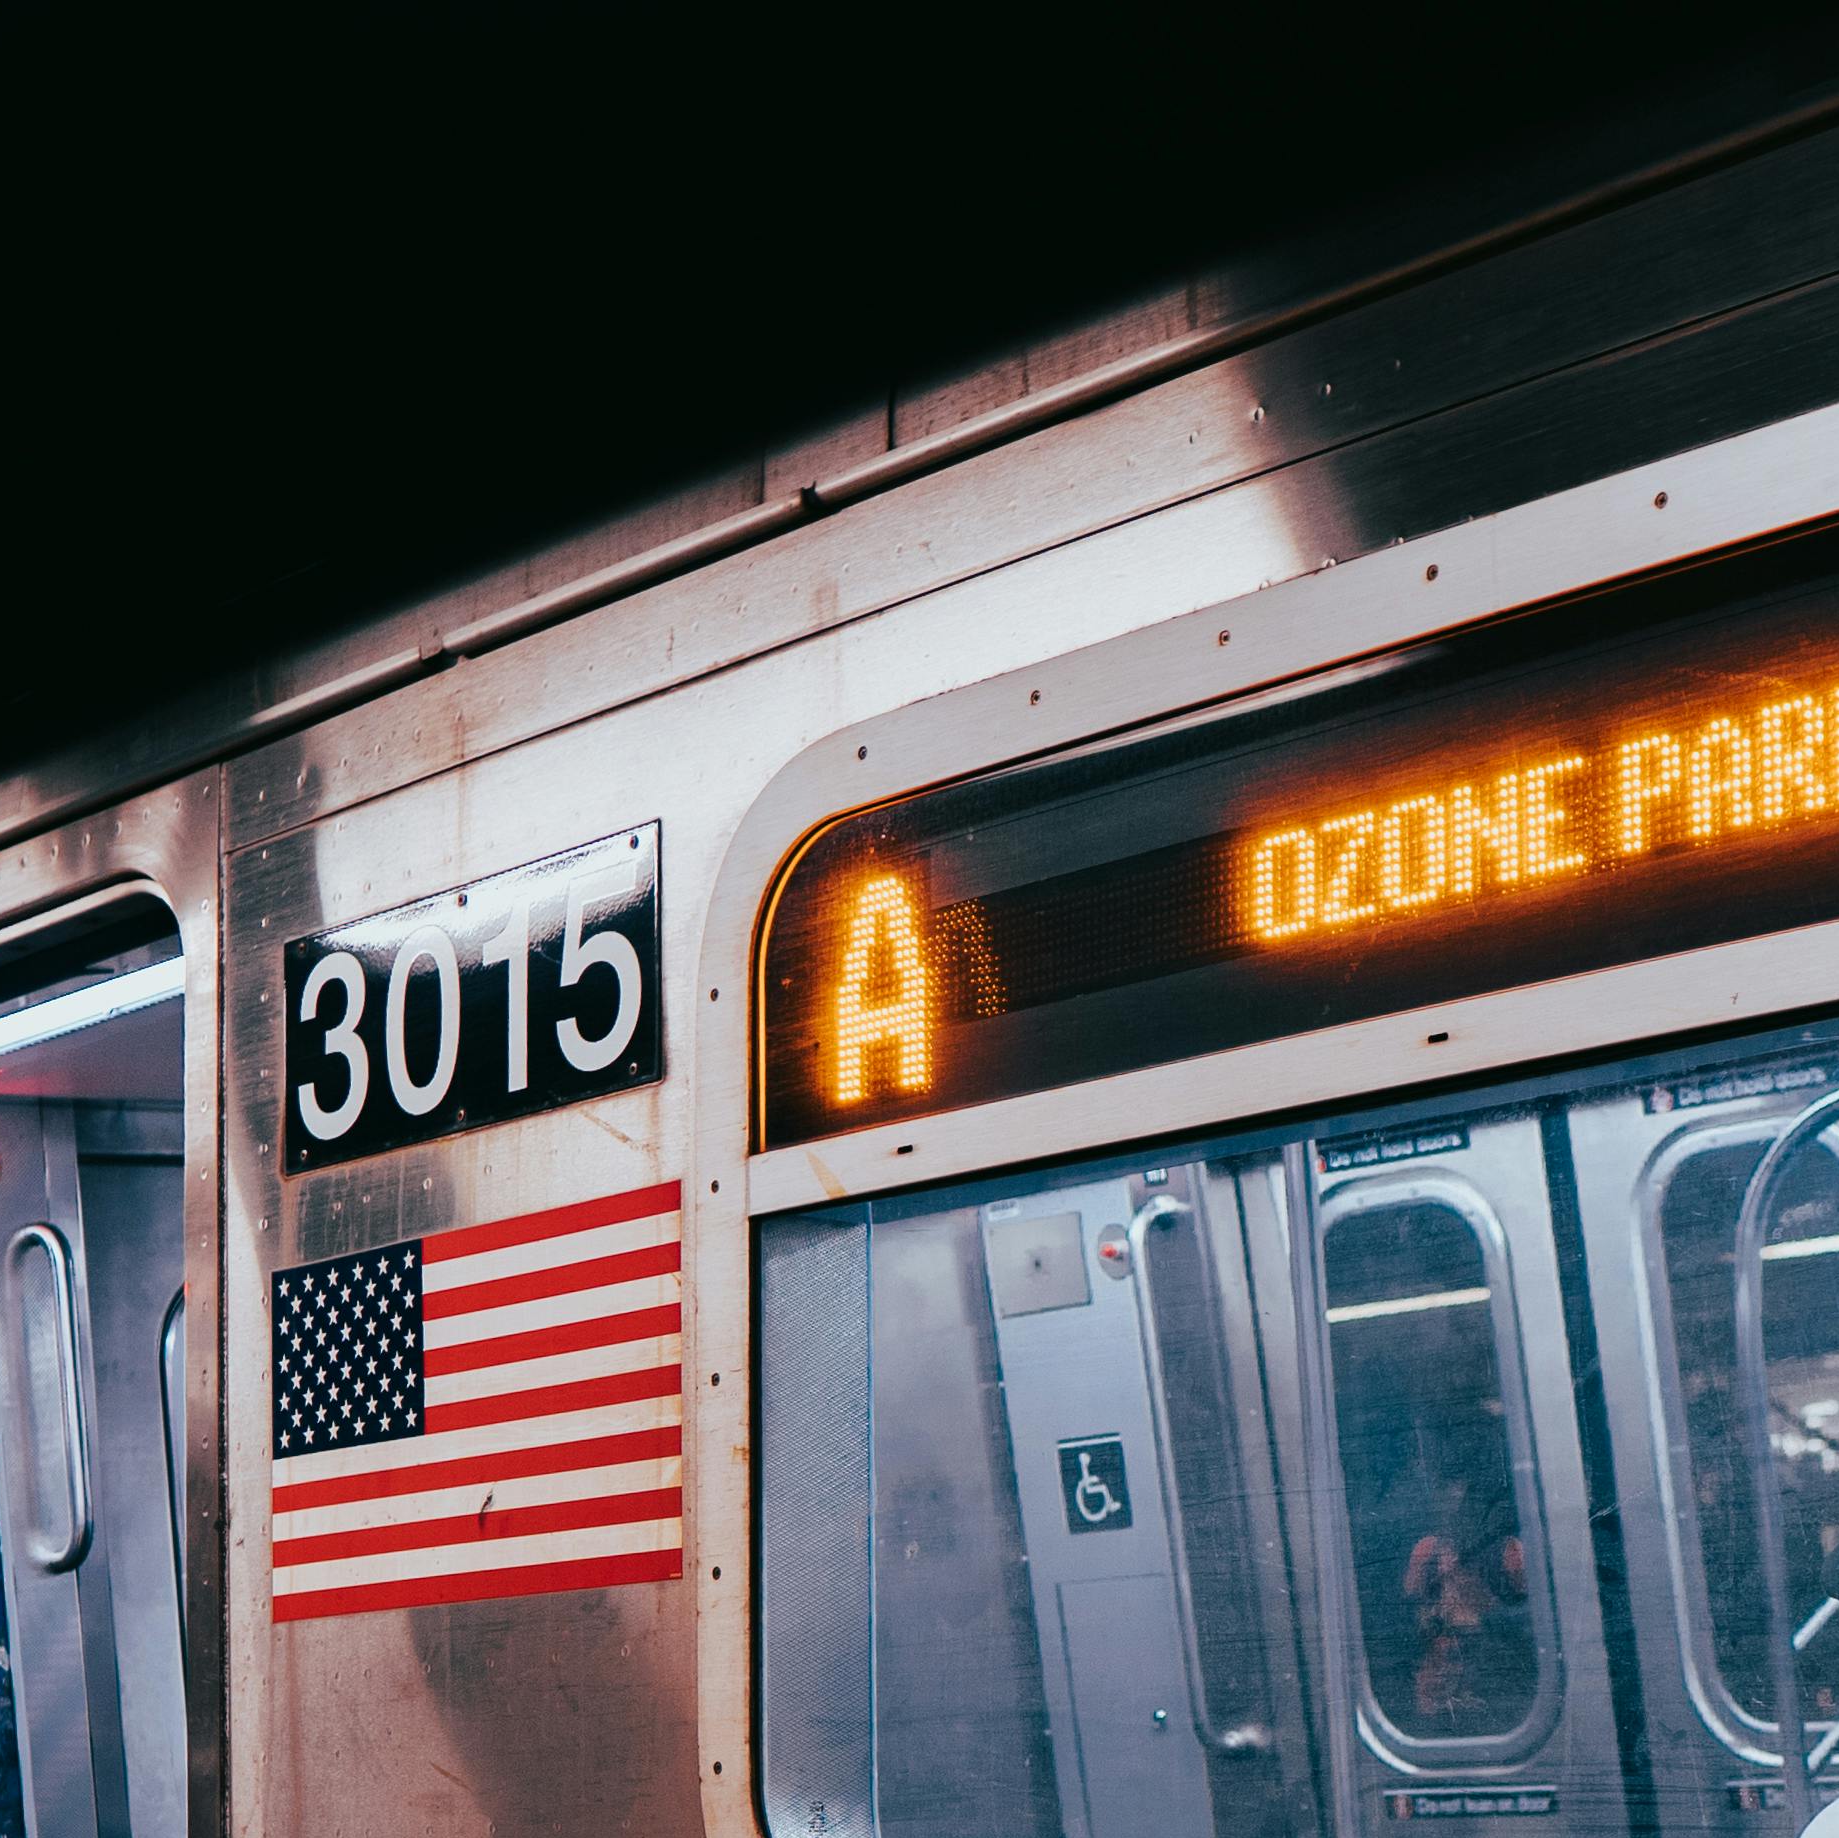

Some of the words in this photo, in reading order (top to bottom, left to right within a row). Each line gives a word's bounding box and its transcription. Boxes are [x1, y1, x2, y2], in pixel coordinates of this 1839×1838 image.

[1251, 756, 1585, 941] OZONE
[298, 859, 642, 1140] 3015
[835, 876, 933, 1103] A
